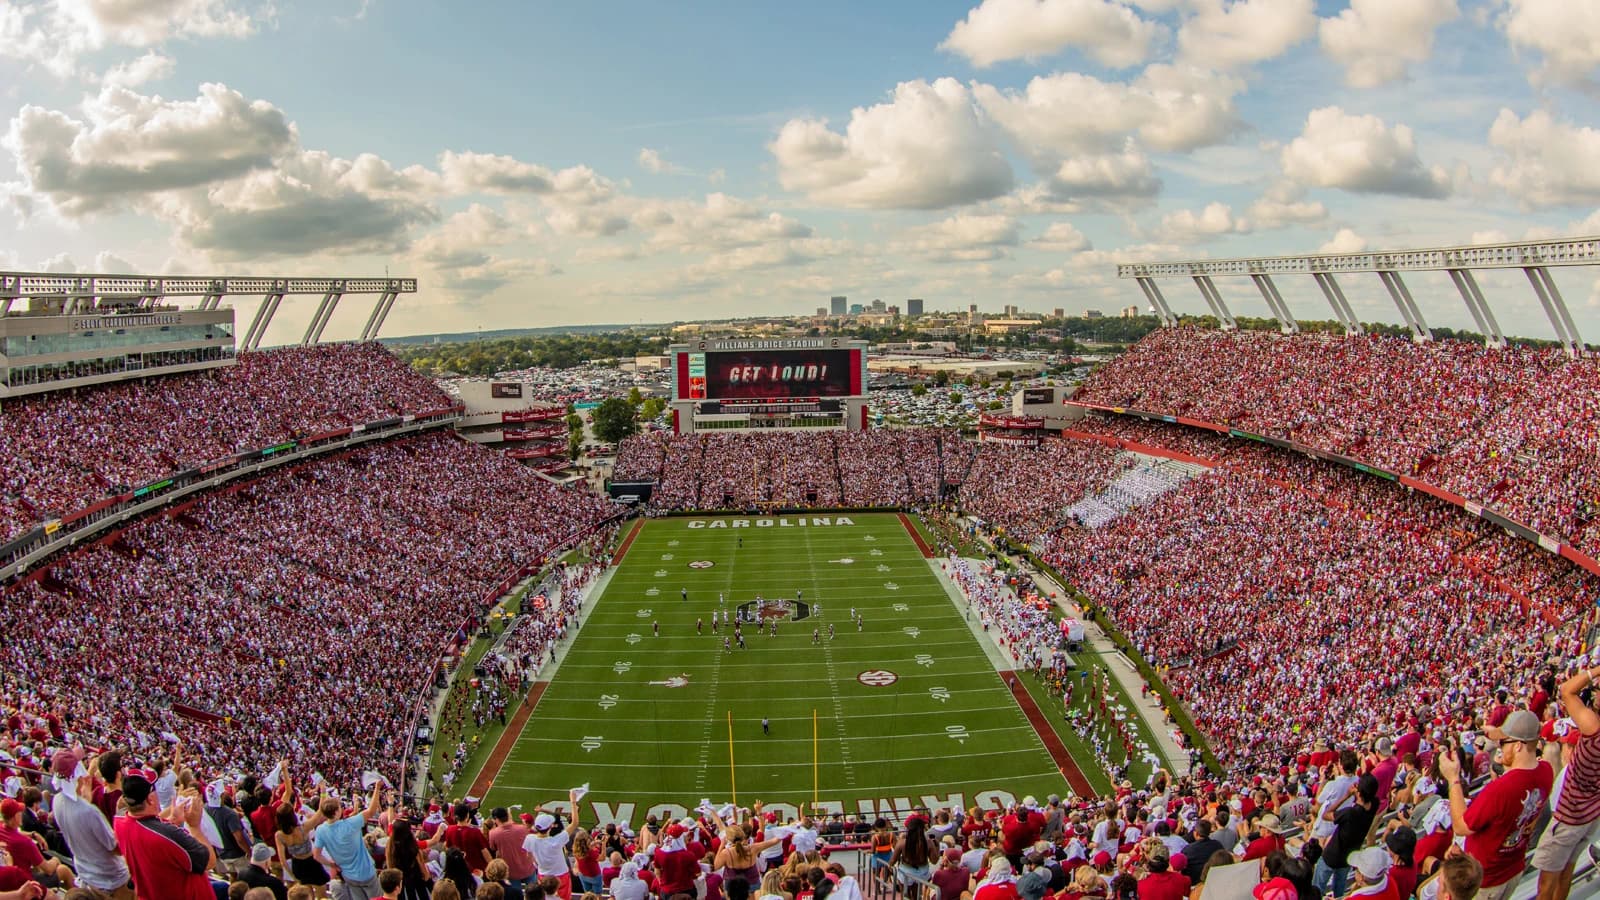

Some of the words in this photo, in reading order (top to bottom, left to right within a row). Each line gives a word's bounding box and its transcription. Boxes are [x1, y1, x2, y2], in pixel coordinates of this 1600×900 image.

[787, 340, 824, 349] STADIUM
[729, 366, 761, 382] GET
[771, 364, 827, 381] LOUD!
[687, 516, 855, 529] CAROLINA
[613, 661, 633, 672] 30
[928, 686, 951, 699] 20
[598, 694, 619, 707] 20
[945, 725, 970, 738] 10
[581, 735, 603, 749] 10
[540, 789, 1017, 831] GAMECCK
